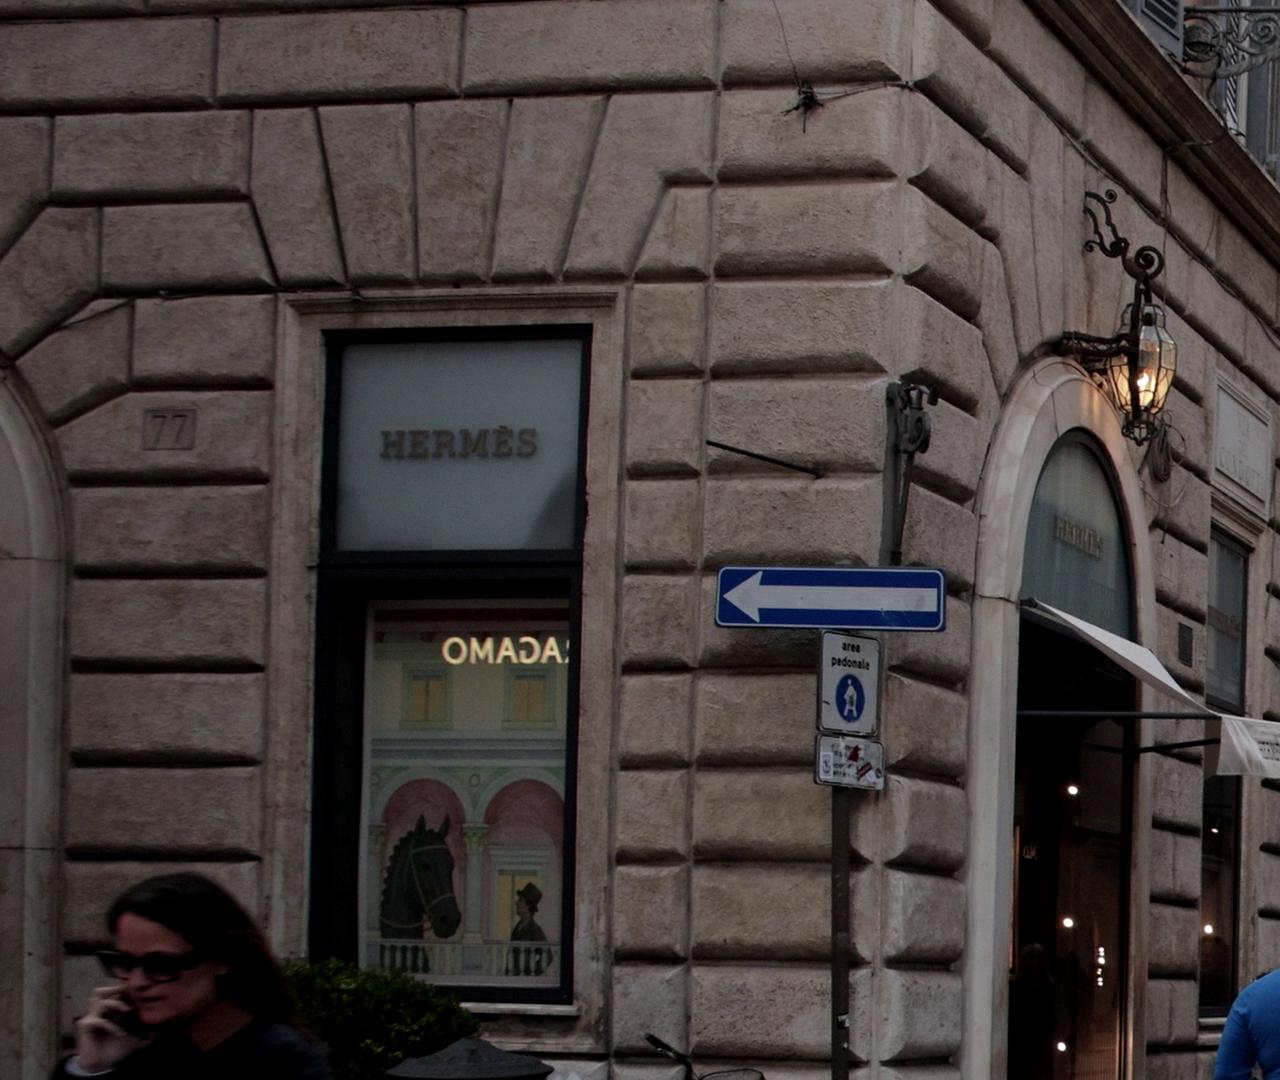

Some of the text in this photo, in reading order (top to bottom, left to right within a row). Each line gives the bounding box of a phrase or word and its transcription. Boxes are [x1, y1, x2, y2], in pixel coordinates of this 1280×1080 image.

[152, 414, 188, 446] 77
[380, 425, 537, 459] HERMÈS
[842, 642, 860, 653] area
[832, 656, 870, 670] pedonale
